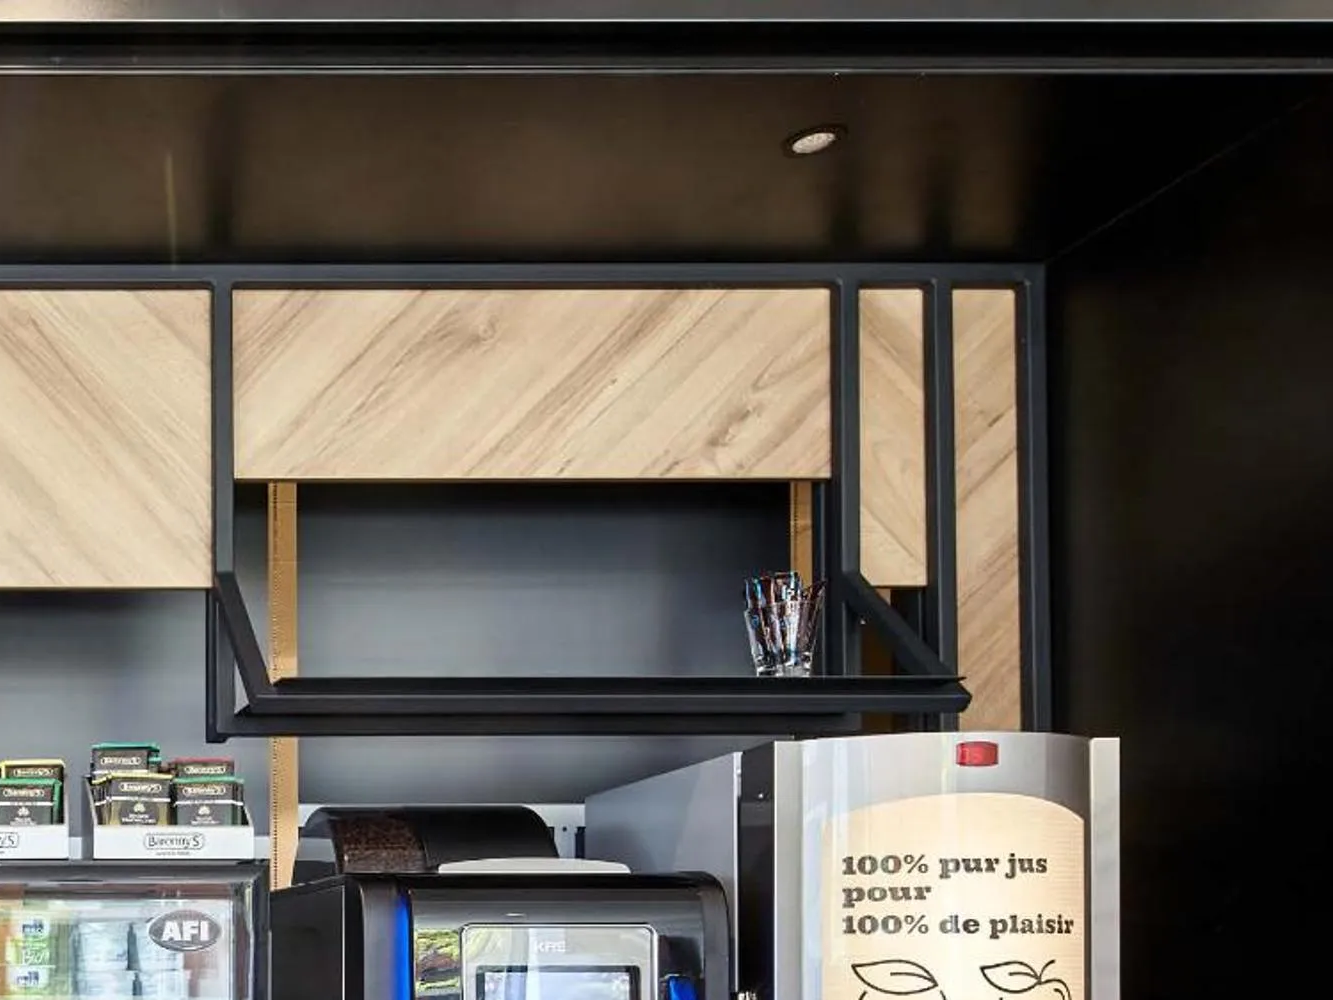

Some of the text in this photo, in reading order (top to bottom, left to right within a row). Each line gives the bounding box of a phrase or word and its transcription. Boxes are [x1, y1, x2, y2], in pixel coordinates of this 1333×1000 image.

[842, 853, 1047, 879] 100% pur jus
[842, 886, 932, 908] pour
[161, 920, 210, 941] AFI
[842, 914, 1074, 940] 100% de plaisir
